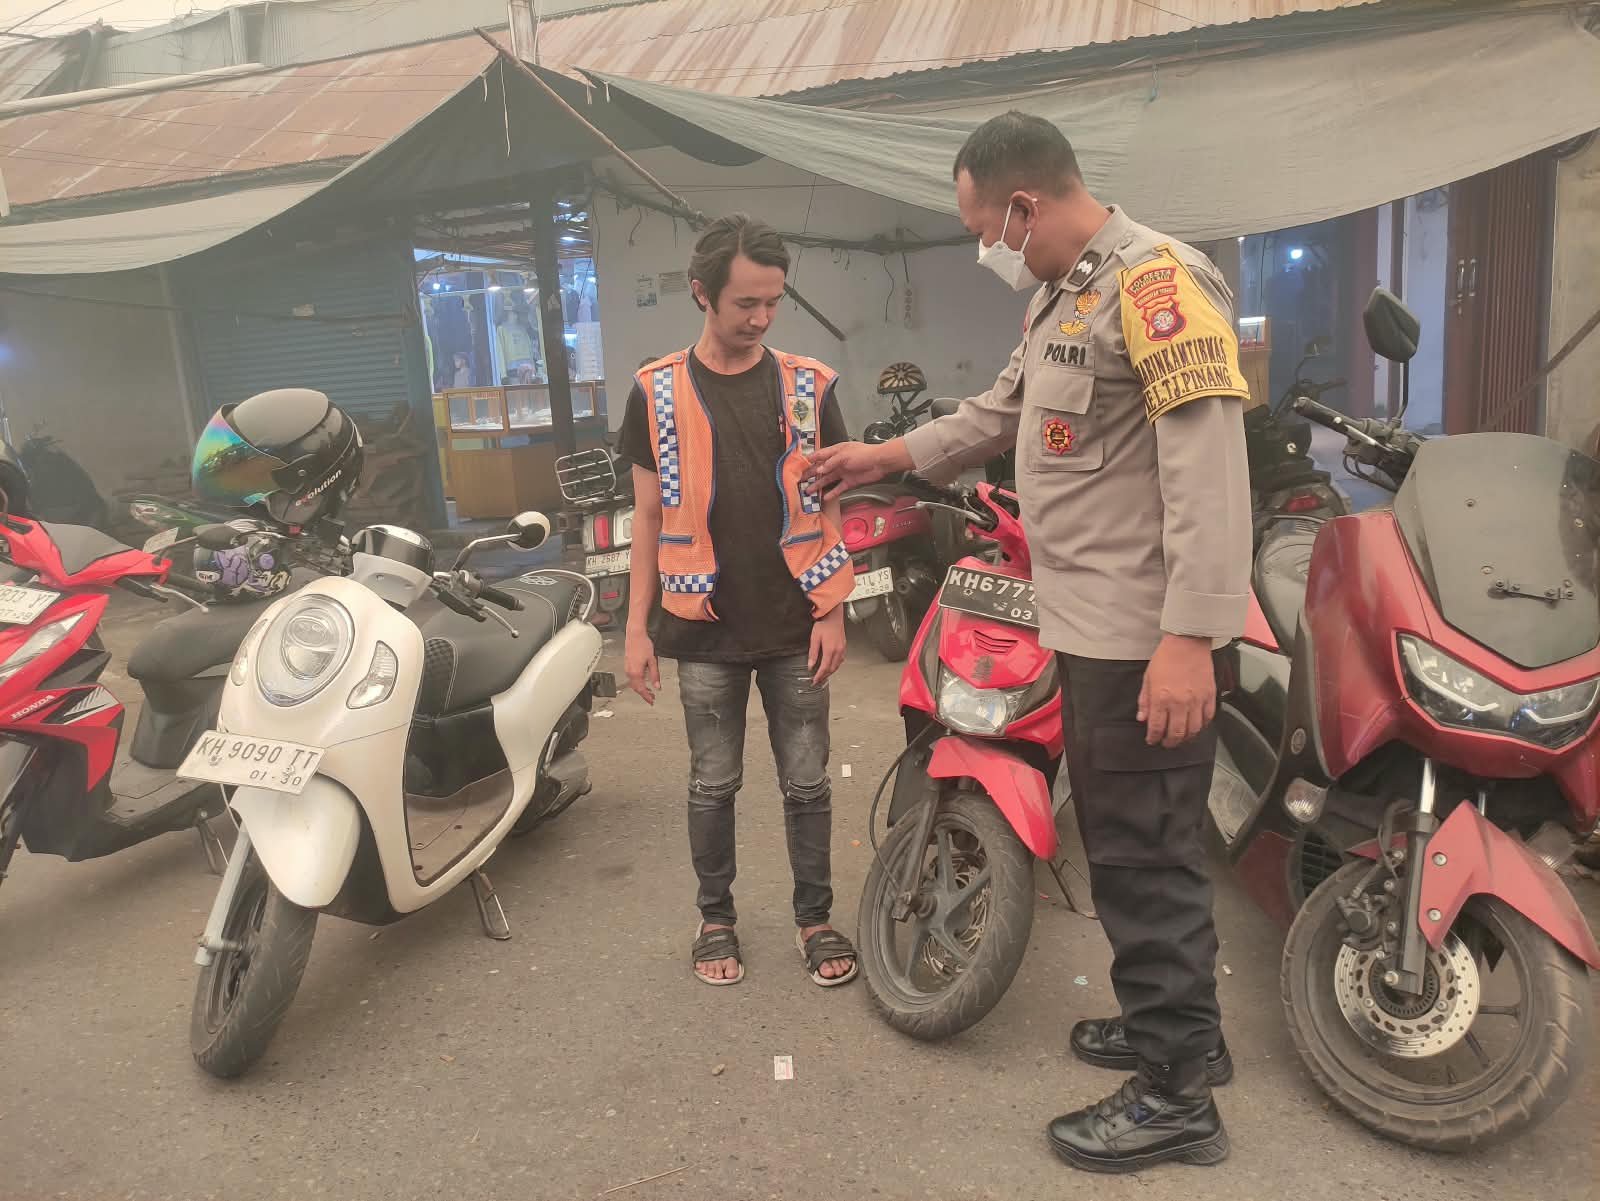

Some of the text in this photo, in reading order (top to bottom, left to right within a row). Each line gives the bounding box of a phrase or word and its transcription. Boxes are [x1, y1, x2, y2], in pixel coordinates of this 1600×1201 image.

[1044, 343, 1087, 365] POLRI
[11, 694, 55, 720] HONDA
[196, 736, 319, 769] KH 9090 TT
